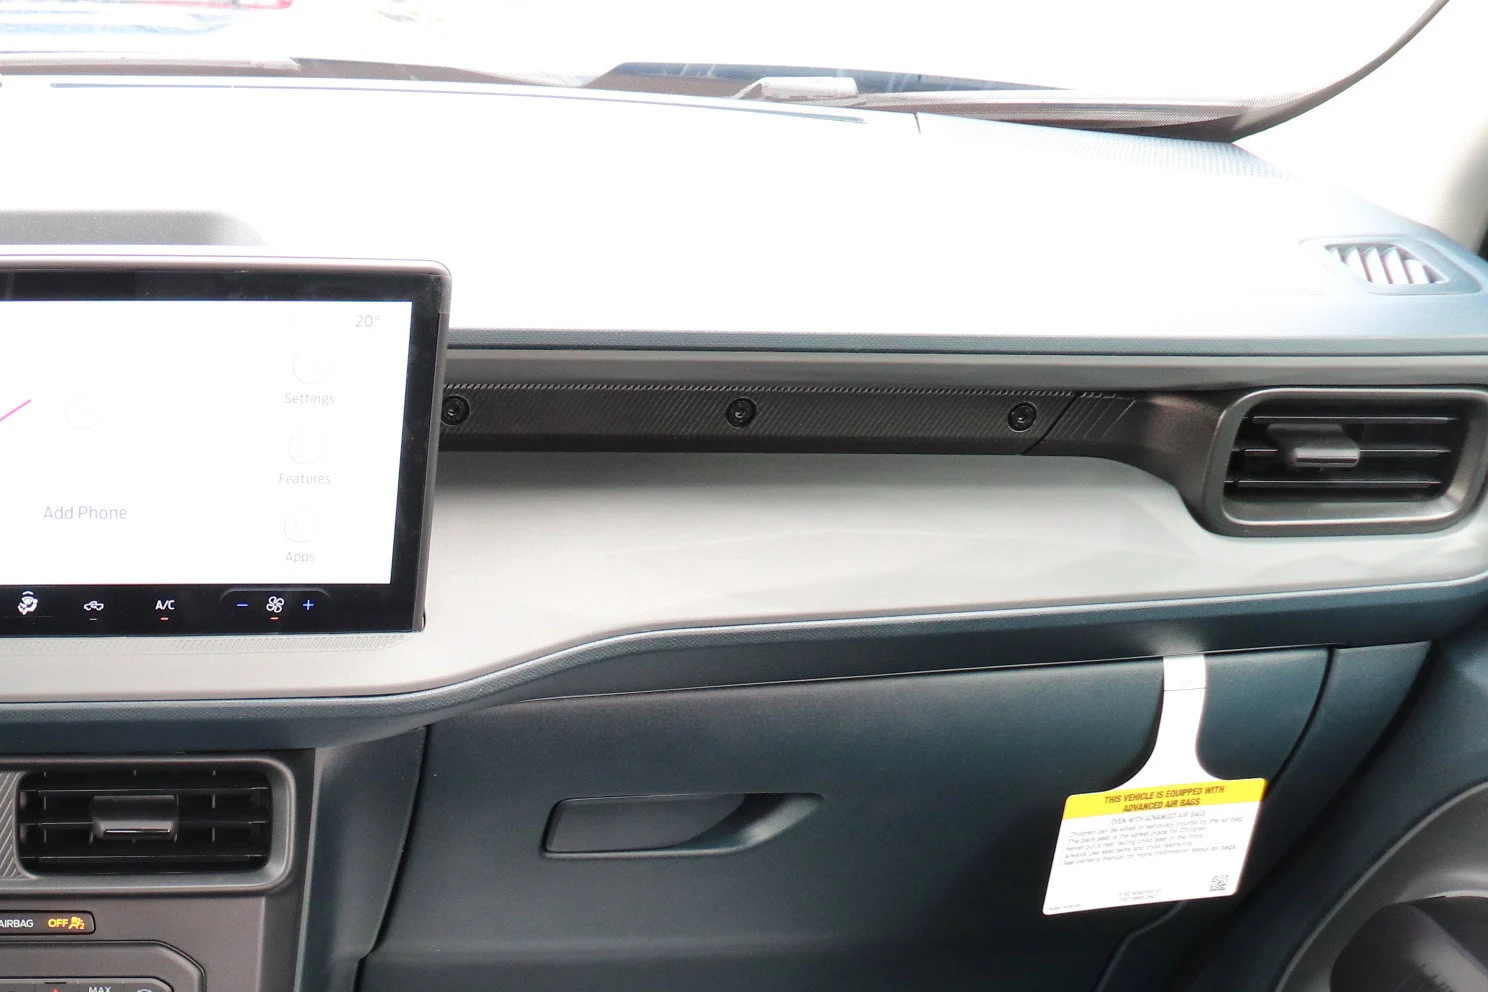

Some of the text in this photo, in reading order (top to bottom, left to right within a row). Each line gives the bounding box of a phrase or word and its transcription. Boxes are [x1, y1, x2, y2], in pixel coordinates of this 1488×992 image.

[284, 391, 335, 406] Settings
[279, 472, 331, 485] Features
[43, 505, 129, 521] Add Phone
[286, 550, 316, 565] Apps
[155, 599, 176, 612] A/C
[1104, 785, 1225, 804] THIS VEHICLE IS EQUIPPED WITH
[1123, 798, 1201, 812] ADVANCED AIR BAGS
[47, 918, 69, 928] OFF
